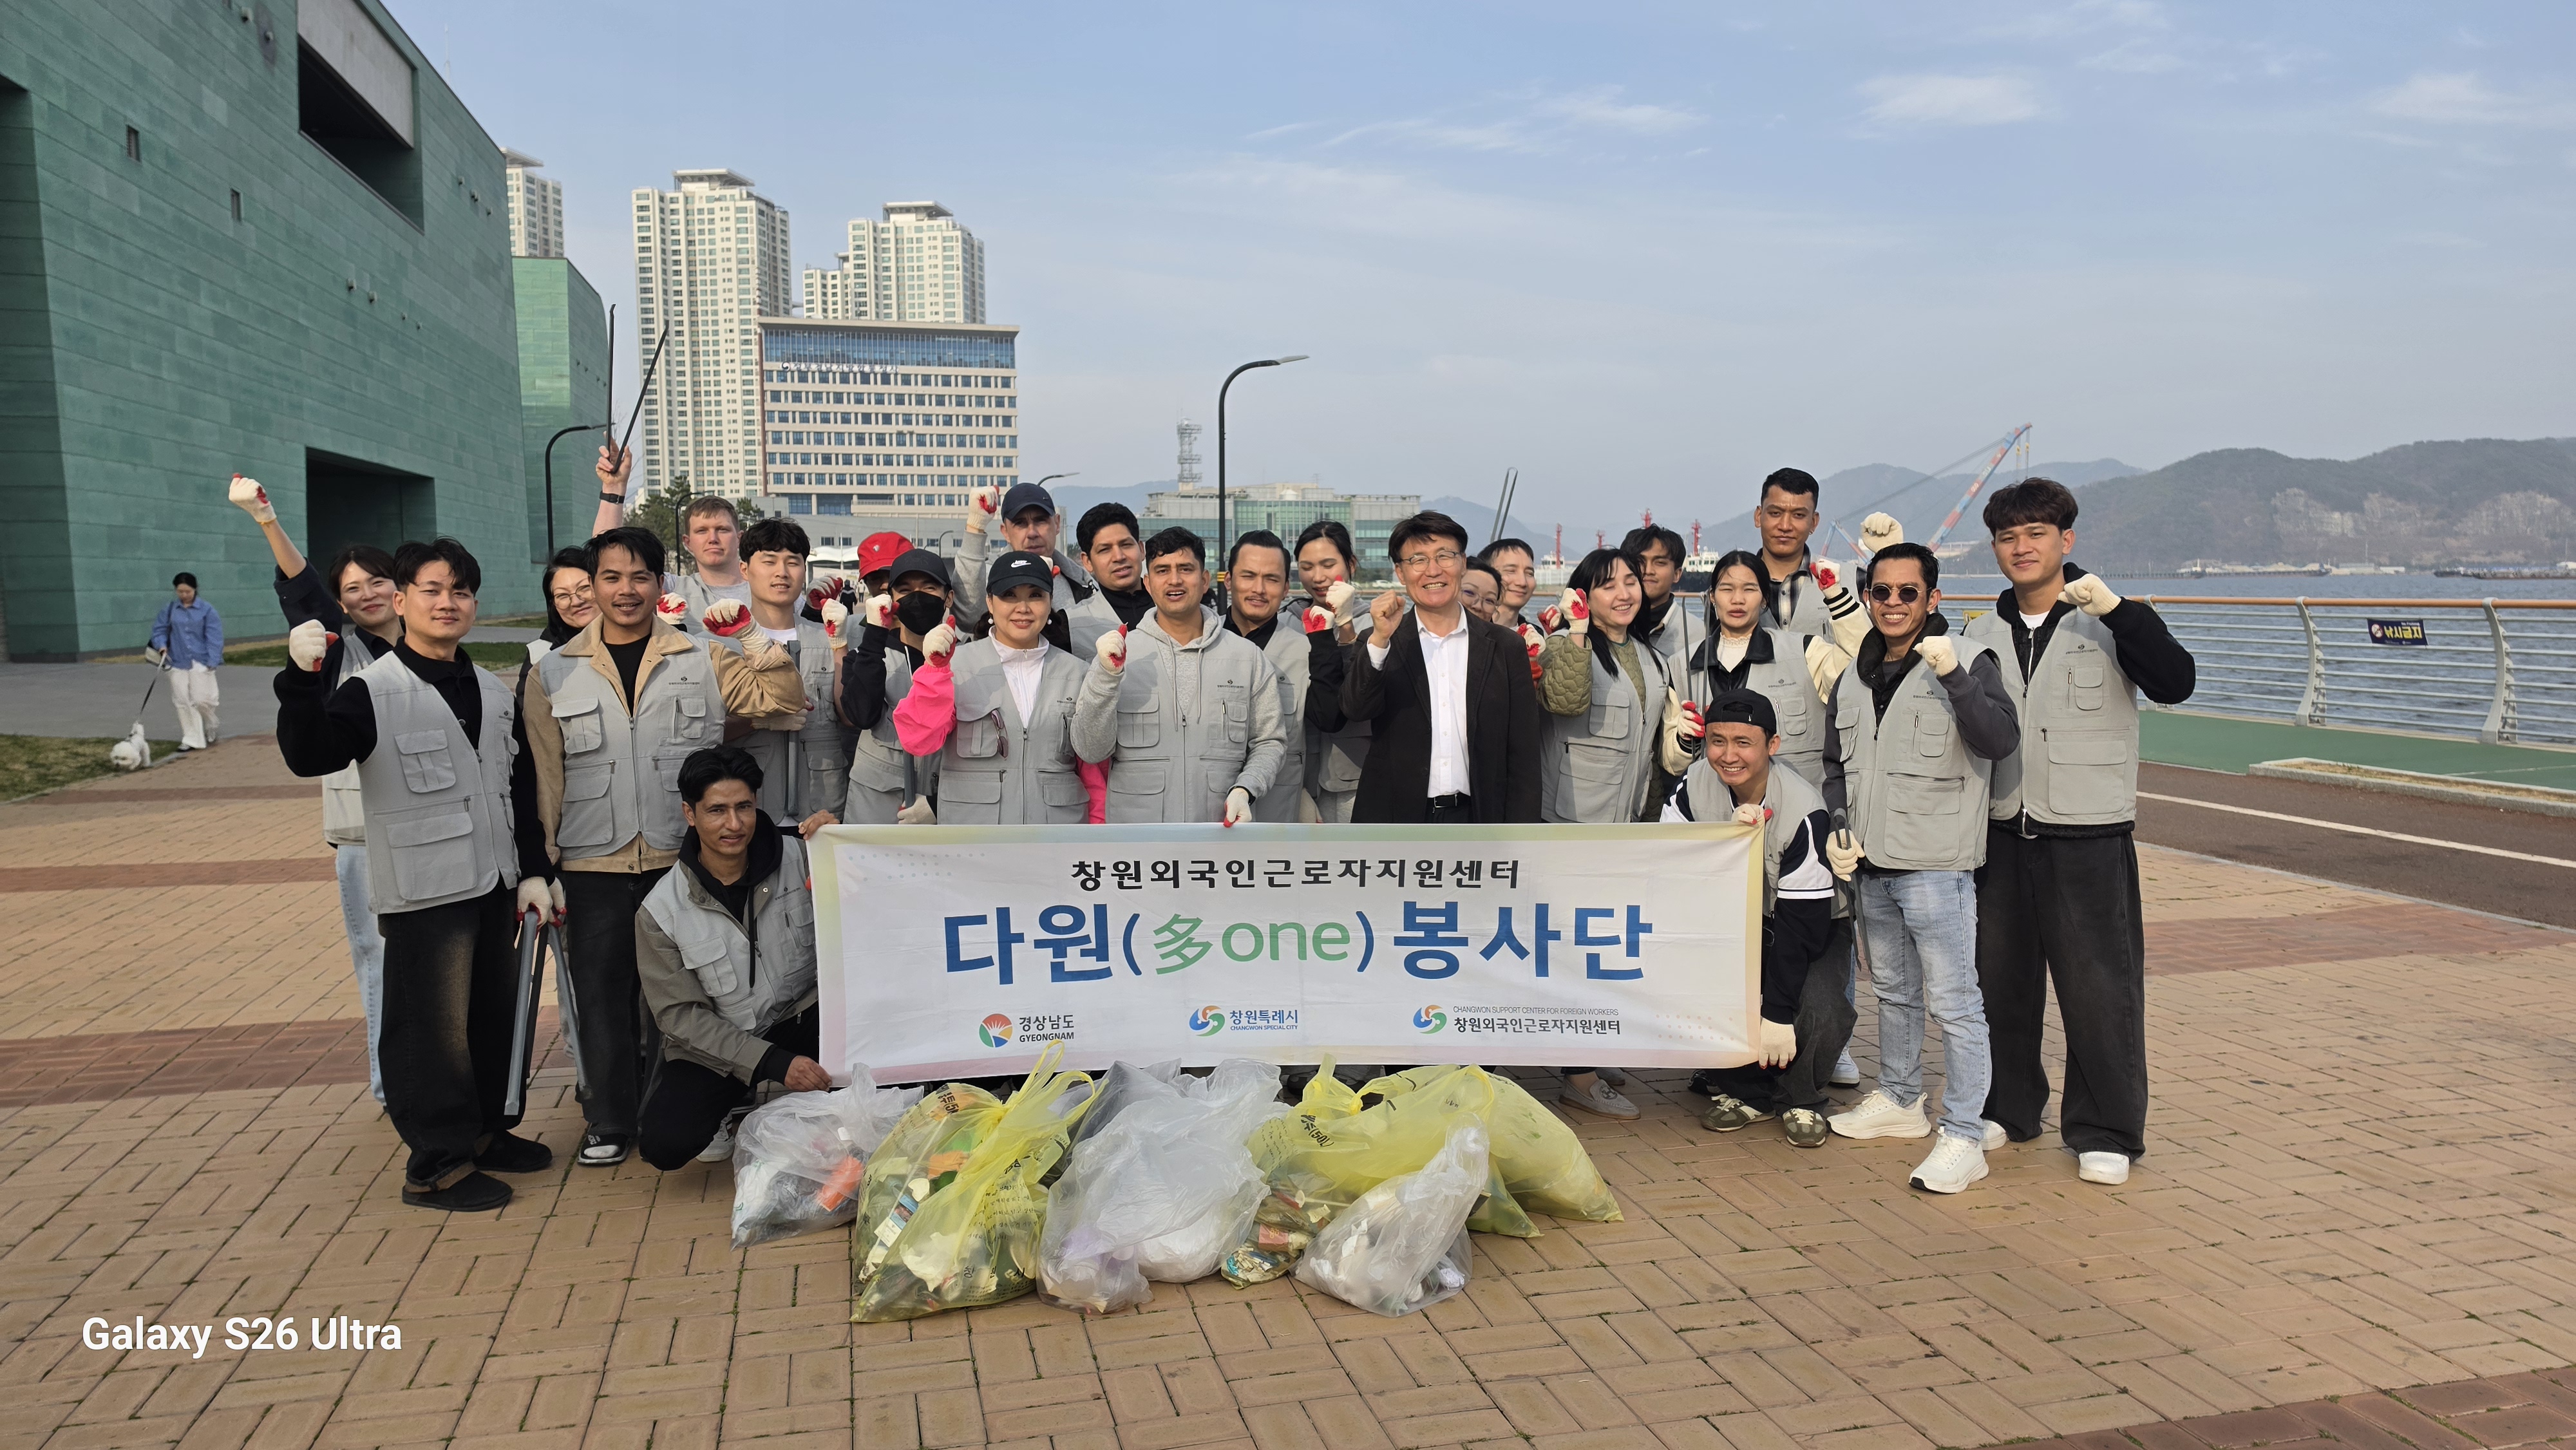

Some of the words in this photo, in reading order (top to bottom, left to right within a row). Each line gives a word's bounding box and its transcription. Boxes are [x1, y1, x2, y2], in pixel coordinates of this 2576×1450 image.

[1071, 860, 1519, 892] 창원외국인근로자지원센터
[1394, 901, 1653, 980] 봉사단
[1019, 1014, 1074, 1030] 경상남도
[1230, 1010, 1298, 1025] 창원특례시
[1454, 1017, 1620, 1035] 창원외국인근로자지원센터
[1019, 1032, 1074, 1043] GYEONGNAM
